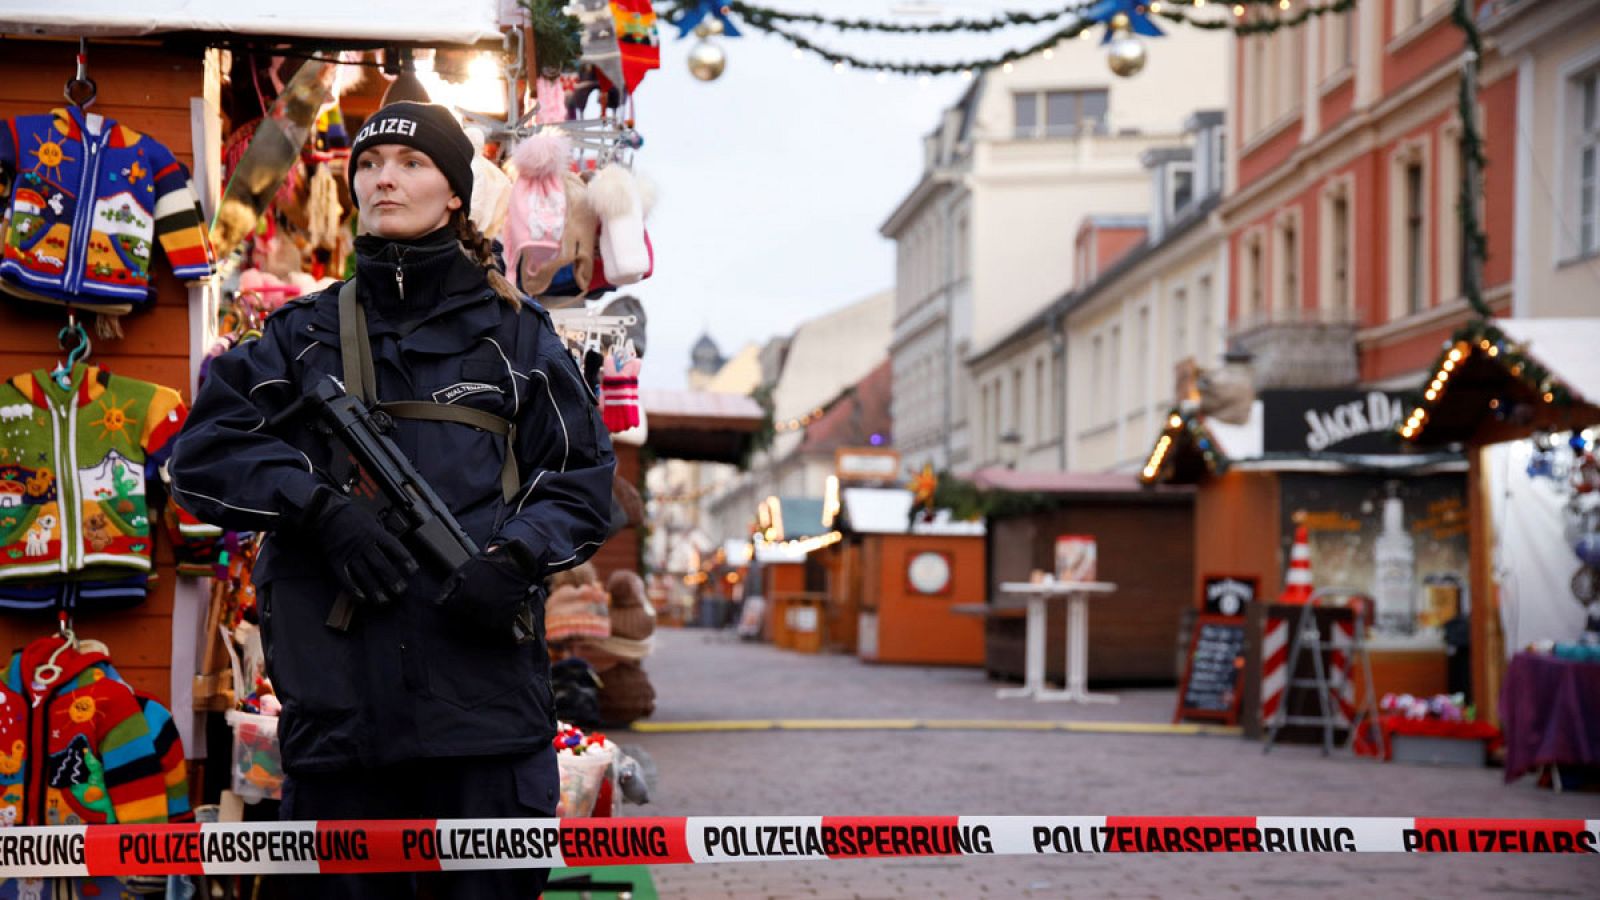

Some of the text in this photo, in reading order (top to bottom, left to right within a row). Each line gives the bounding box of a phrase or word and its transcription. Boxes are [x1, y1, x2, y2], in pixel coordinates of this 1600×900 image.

[1304, 400, 1369, 451] JACK
[119, 829, 368, 864] POLIZEIABSPERRUNG
[402, 826, 669, 860] POLIZEIABSPERRUNG
[703, 825, 995, 856] POLIZEIABSPERRUNG
[1032, 826, 1357, 853] POLIZEIABSPERRUNG
[1402, 828, 1600, 853] POLIZEIABS
